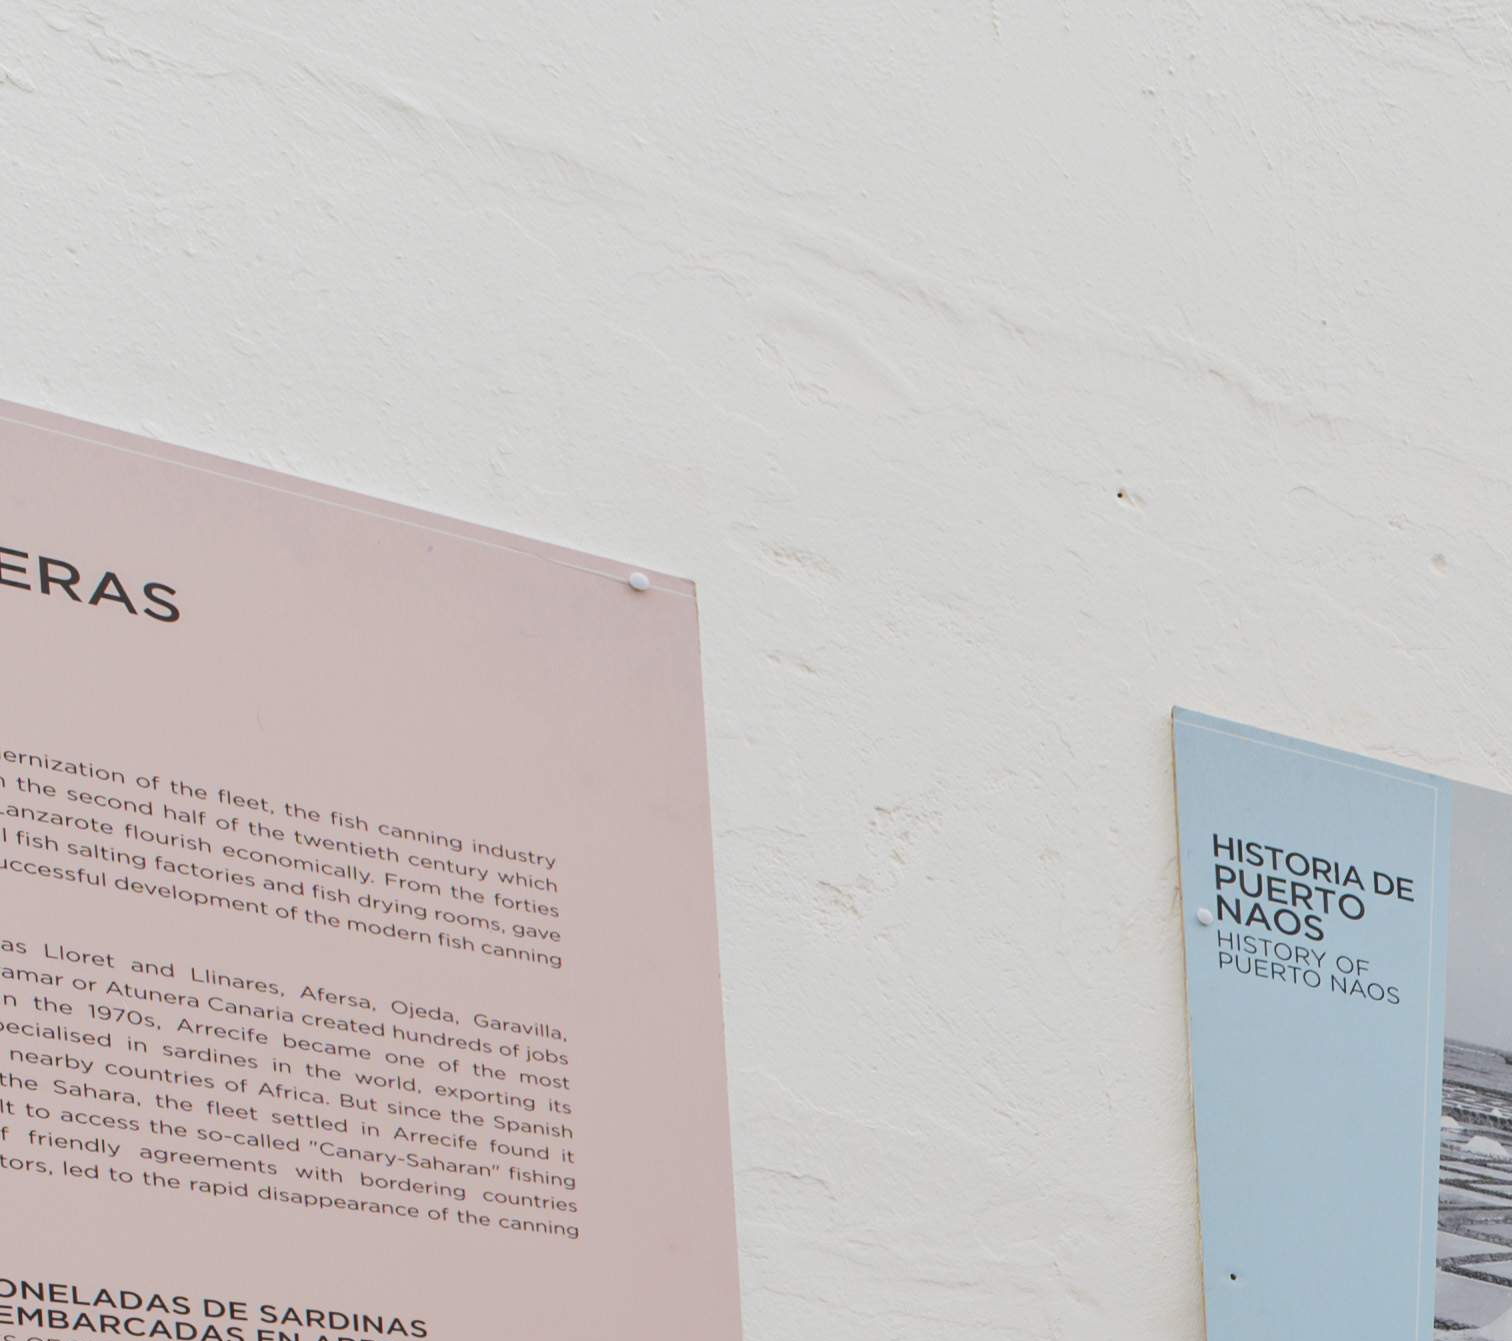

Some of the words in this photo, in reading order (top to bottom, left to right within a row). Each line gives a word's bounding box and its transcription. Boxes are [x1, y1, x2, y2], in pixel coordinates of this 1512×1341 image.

[0, 546, 180, 623] ERAS
[2, 750, 125, 784] ernization
[135, 775, 159, 791] of
[170, 780, 207, 800] the
[217, 788, 274, 815] fleet,
[284, 802, 320, 822] the
[330, 810, 368, 831] fish
[377, 824, 462, 852] canning
[472, 842, 555, 870] industry
[16, 776, 56, 797] the
[66, 789, 153, 816] second
[163, 803, 206, 825] half
[215, 817, 238, 831] of
[248, 821, 285, 841] the
[293, 830, 399, 863] twentieth
[407, 855, 488, 881] century
[497, 871, 557, 893] which
[0, 804, 113, 835] anzarote
[124, 823, 211, 854] flourish
[222, 845, 374, 885] economically.
[384, 872, 441, 896] From
[450, 885, 484, 904] the
[494, 892, 559, 917] forties
[15, 829, 59, 852] fish
[67, 843, 146, 870] salting
[154, 855, 255, 887] factories
[263, 878, 304, 896] and
[311, 884, 350, 904] fish
[357, 893, 427, 921] drying
[434, 909, 505, 934] rooms,
[511, 924, 561, 942] gave
[1212, 833, 1365, 891] HISTORIA
[1373, 870, 1414, 902] DE
[1214, 863, 1365, 921] PUERTO
[0, 858, 106, 887] uccessful
[114, 875, 267, 916] development
[275, 905, 297, 921] of
[304, 908, 340, 928] the
[347, 919, 431, 944] modern
[437, 932, 474, 951] fish
[480, 943, 562, 969] canning
[1216, 893, 1324, 942] NAOS
[1217, 929, 1326, 969] HISTORY
[1335, 955, 1370, 977] OF
[1218, 951, 1321, 988] PUERTO
[1330, 974, 1400, 1005] NAOS
[44, 942, 114, 969] Lloret
[130, 960, 174, 978] and
[191, 966, 284, 997] Llinares,
[299, 985, 376, 1011] Afersa,
[390, 999, 459, 1025] Ojeda,
[473, 1013, 567, 1042] Garavilla,
[0, 1277, 191, 1315] ONELADAS
[203, 1298, 248, 1321] DE
[259, 1304, 427, 1338] SARDINAS
